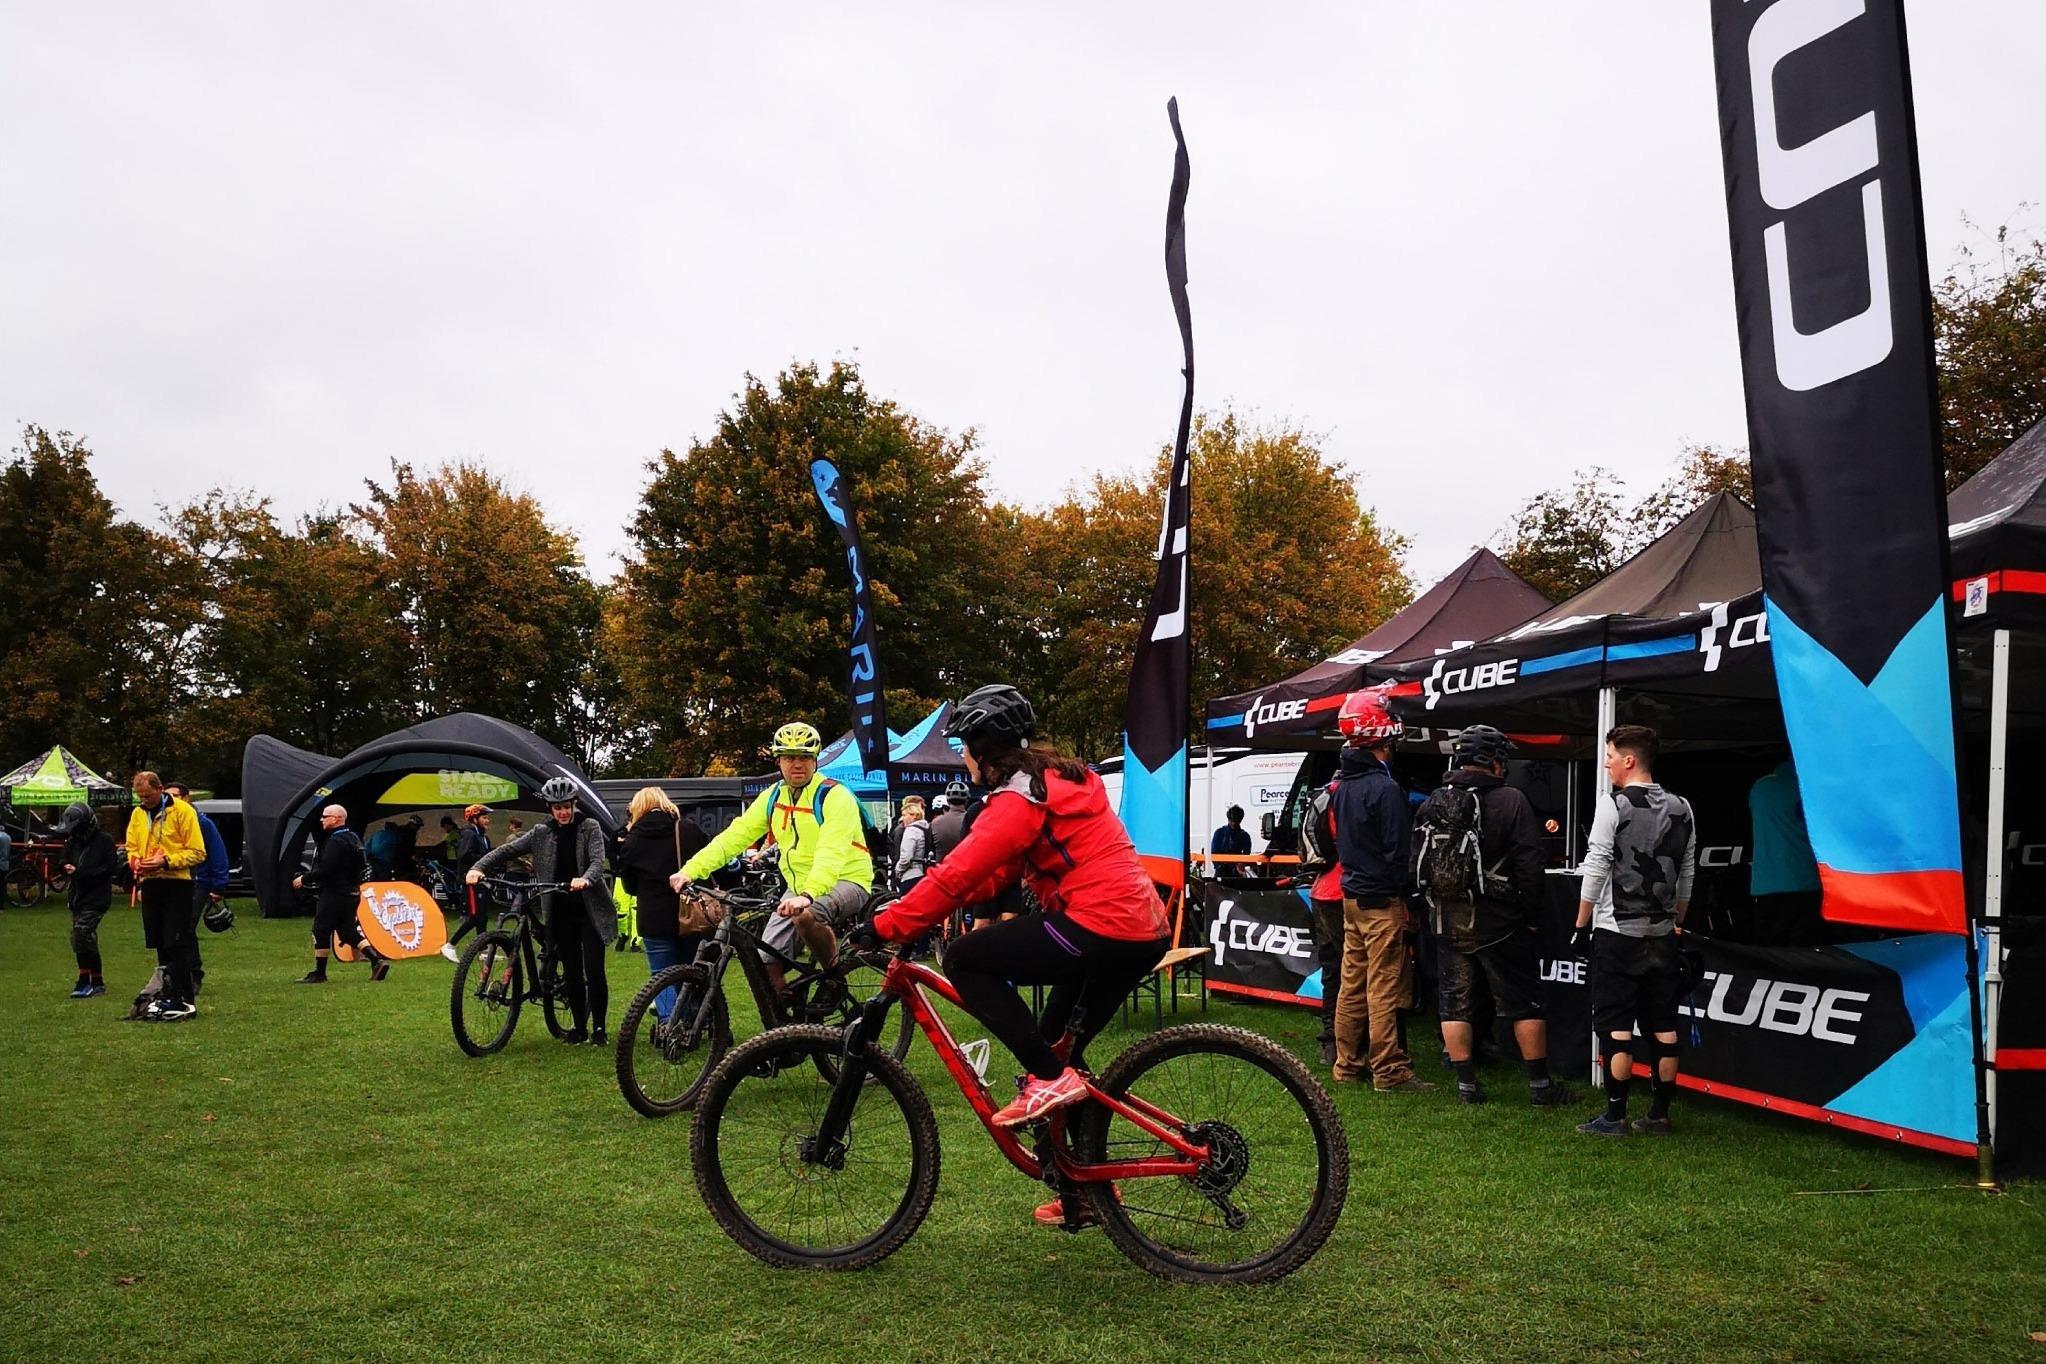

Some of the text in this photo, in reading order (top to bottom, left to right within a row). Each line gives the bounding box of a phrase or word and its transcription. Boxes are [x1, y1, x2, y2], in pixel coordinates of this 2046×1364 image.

[1729, 612, 1770, 648] CU
[1443, 658, 1518, 695] CUBE
[1256, 698, 1309, 725] CUBE
[901, 772, 947, 783] MARIN
[1229, 919, 1314, 959] CUBE
[1539, 958, 1587, 985] UBE
